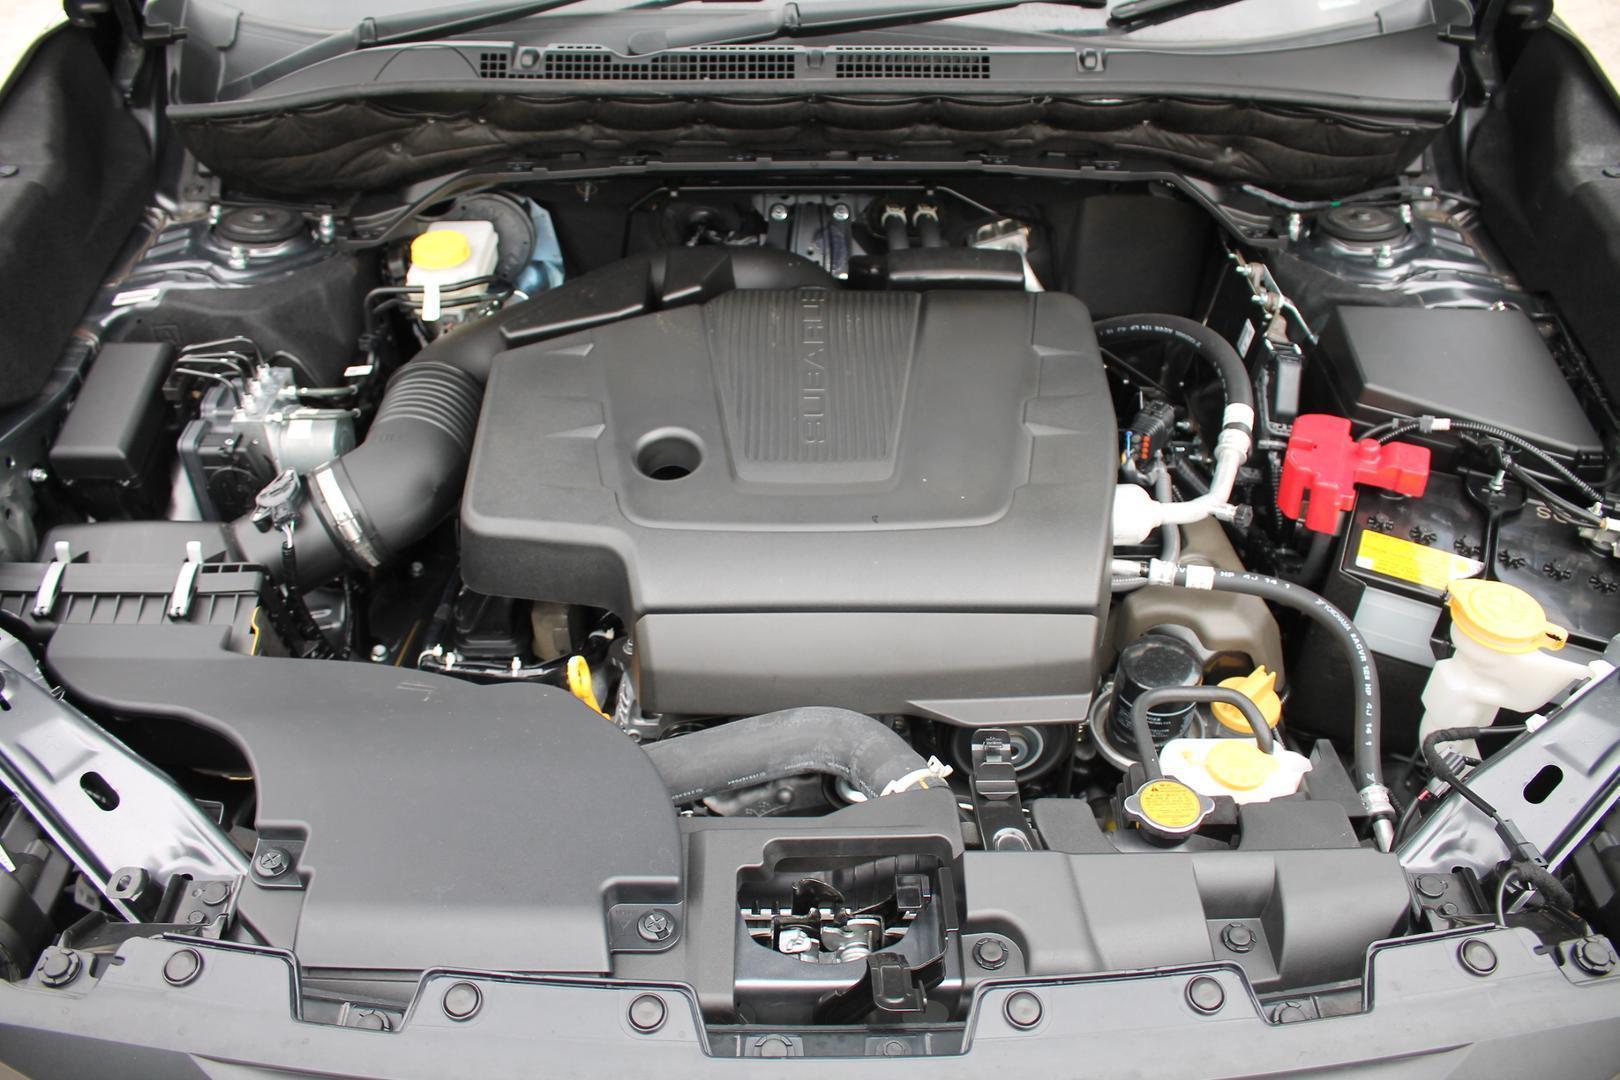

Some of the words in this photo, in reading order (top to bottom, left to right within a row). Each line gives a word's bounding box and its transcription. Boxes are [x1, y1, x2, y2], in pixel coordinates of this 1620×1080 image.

[802, 304, 825, 444] SUBARU
[1220, 570, 1235, 578] HP
[1324, 604, 1352, 632] YOKOHAMA
[1364, 683, 1372, 697] HP
[1365, 702, 1373, 716] 4J
